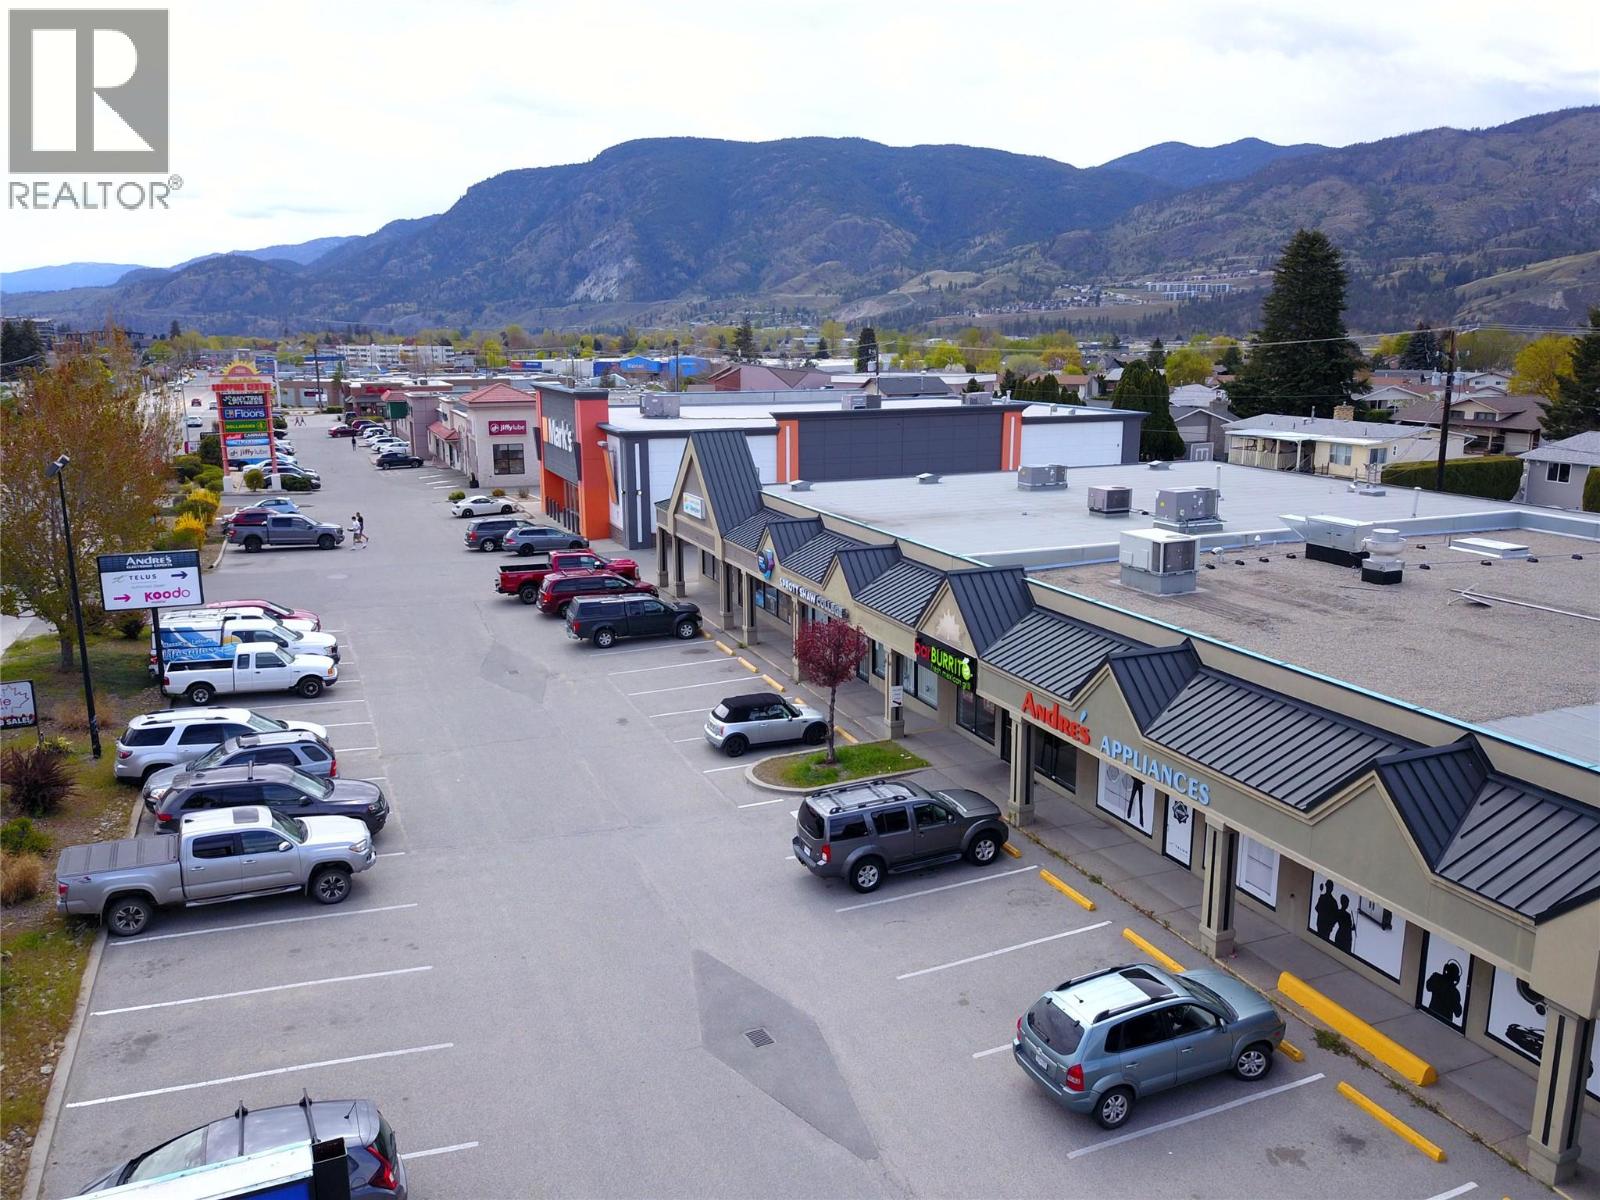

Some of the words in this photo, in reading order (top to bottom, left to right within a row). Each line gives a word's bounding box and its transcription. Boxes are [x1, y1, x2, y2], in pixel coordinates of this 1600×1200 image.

[234, 409, 265, 418] Floors
[548, 418, 572, 453] Mark's
[780, 577, 799, 595] SPROTT
[799, 587, 816, 604] SHAW
[816, 596, 843, 618] COLLEGE
[1100, 735, 1211, 806] APPLIANCES
